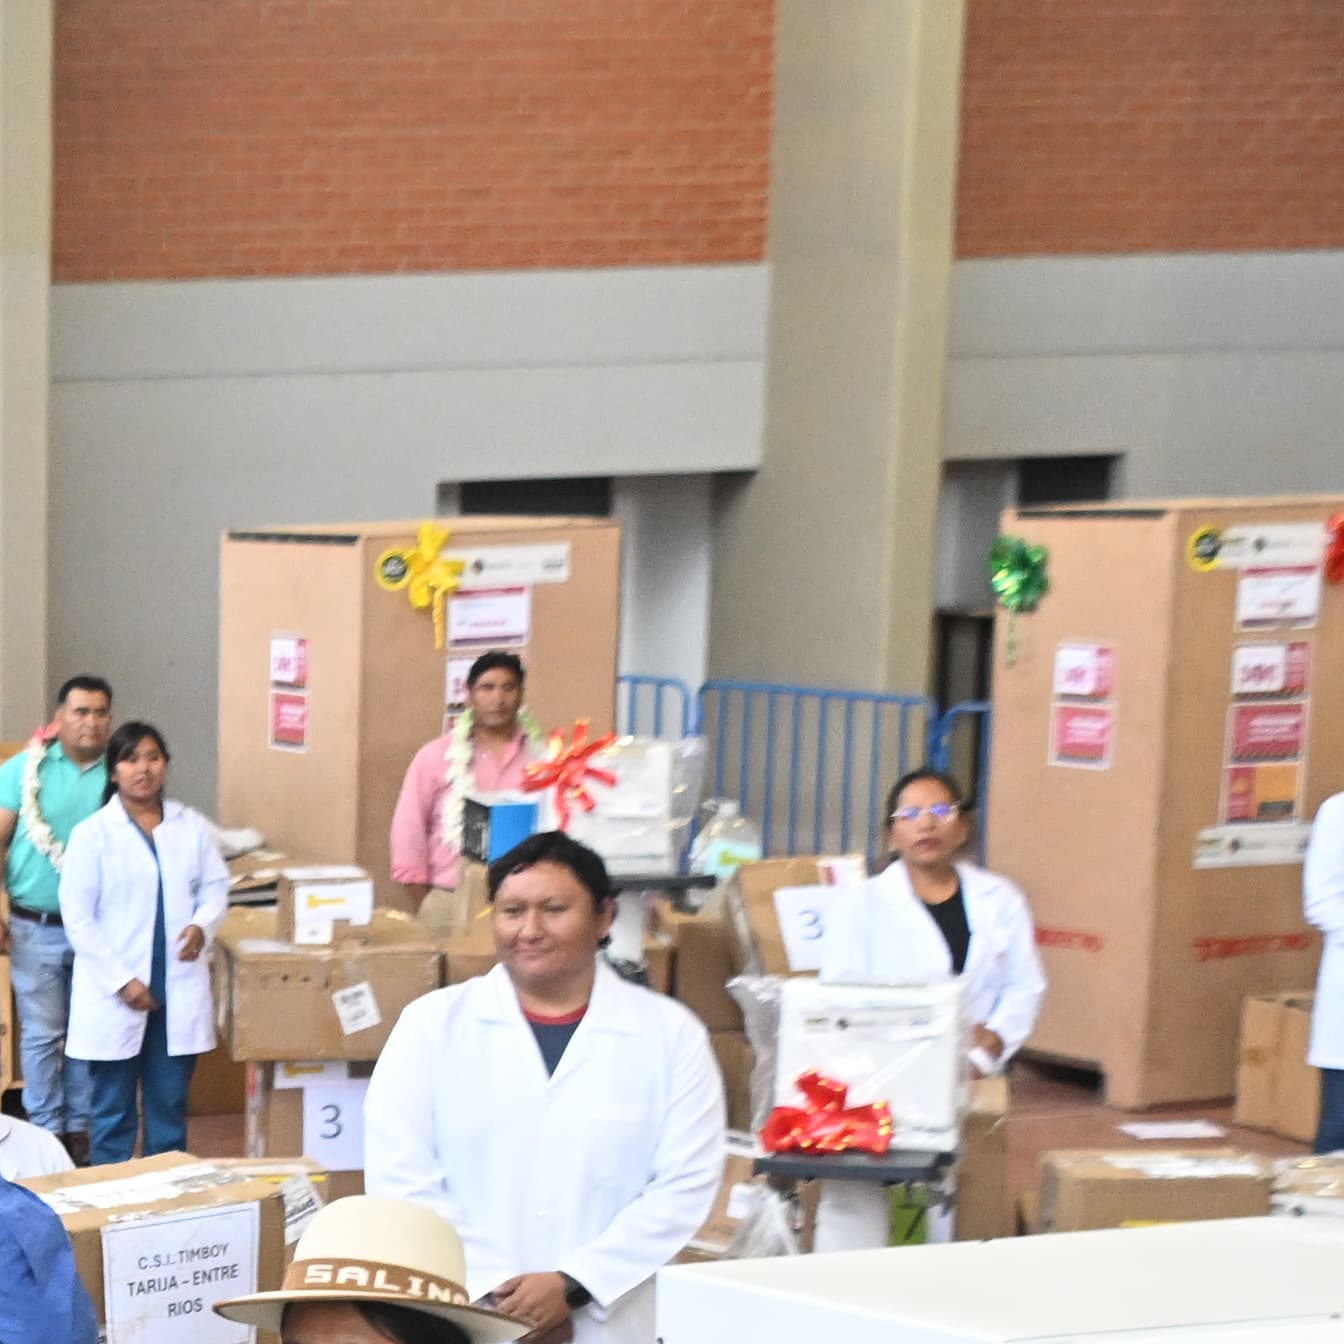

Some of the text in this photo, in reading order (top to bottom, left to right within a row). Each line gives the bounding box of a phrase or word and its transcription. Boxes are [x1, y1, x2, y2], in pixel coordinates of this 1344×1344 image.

[797, 909, 824, 941] 3
[320, 1104, 342, 1139] 3
[178, 1243, 229, 1264] TIMBOY
[127, 1277, 178, 1297] TARIJA
[192, 1264, 239, 1285] ENTRE
[167, 1298, 203, 1318] RIOS
